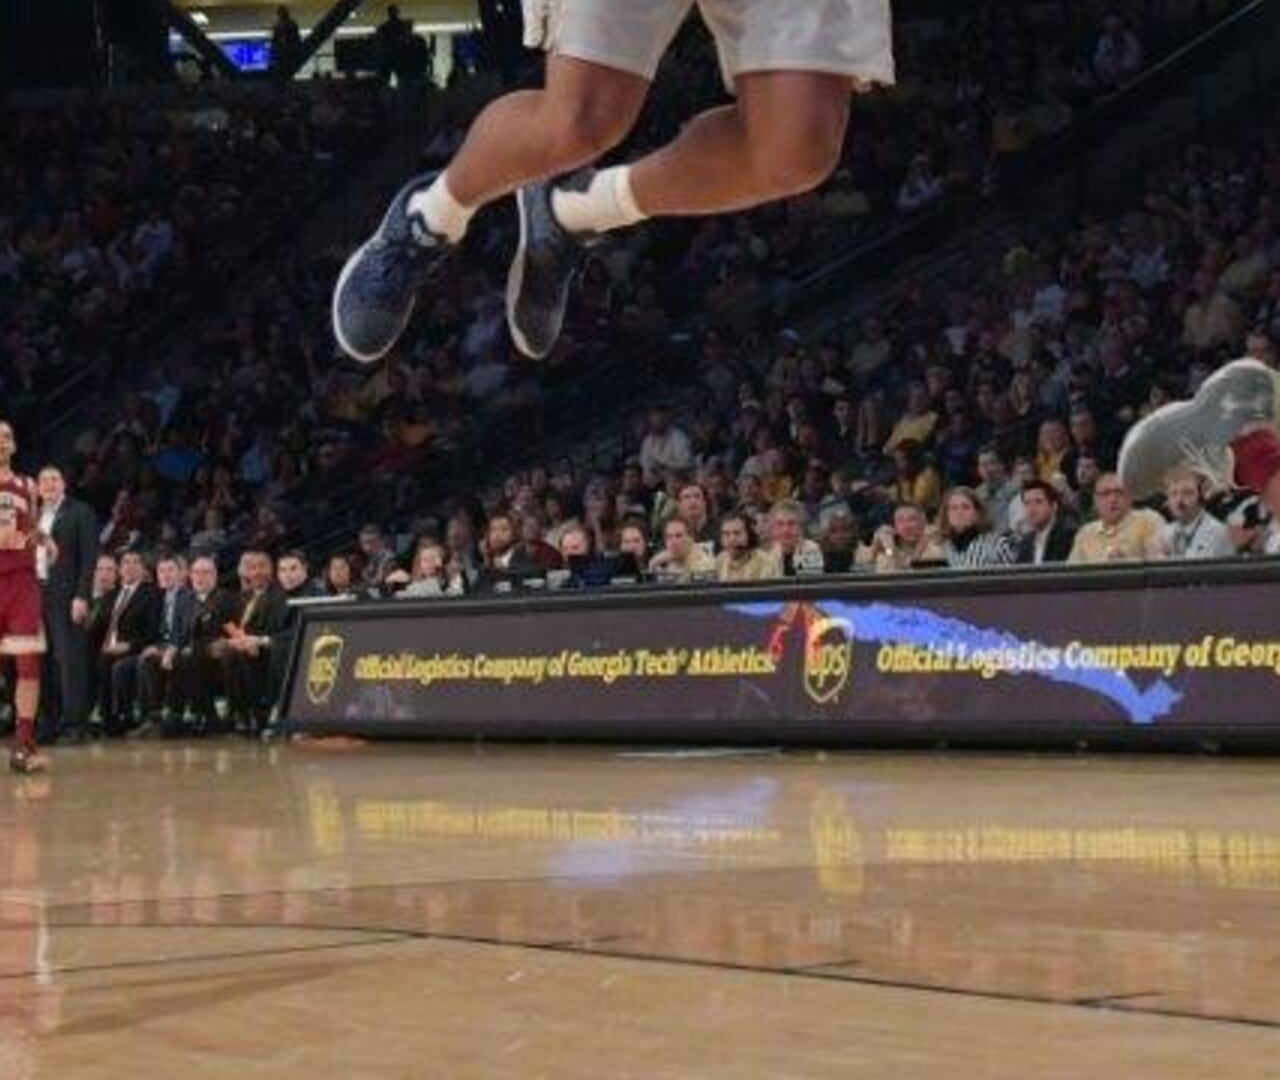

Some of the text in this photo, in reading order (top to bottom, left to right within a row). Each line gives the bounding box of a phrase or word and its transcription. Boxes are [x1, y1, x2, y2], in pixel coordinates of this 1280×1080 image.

[354, 651, 402, 680] Official
[404, 652, 472, 685] Logistics
[474, 653, 547, 685] Company
[548, 650, 569, 677] of
[568, 651, 632, 684] Georgia
[876, 641, 954, 673] Official
[956, 640, 1061, 680] Logistics
[1064, 640, 1180, 677] Company
[1184, 634, 1214, 668] of
